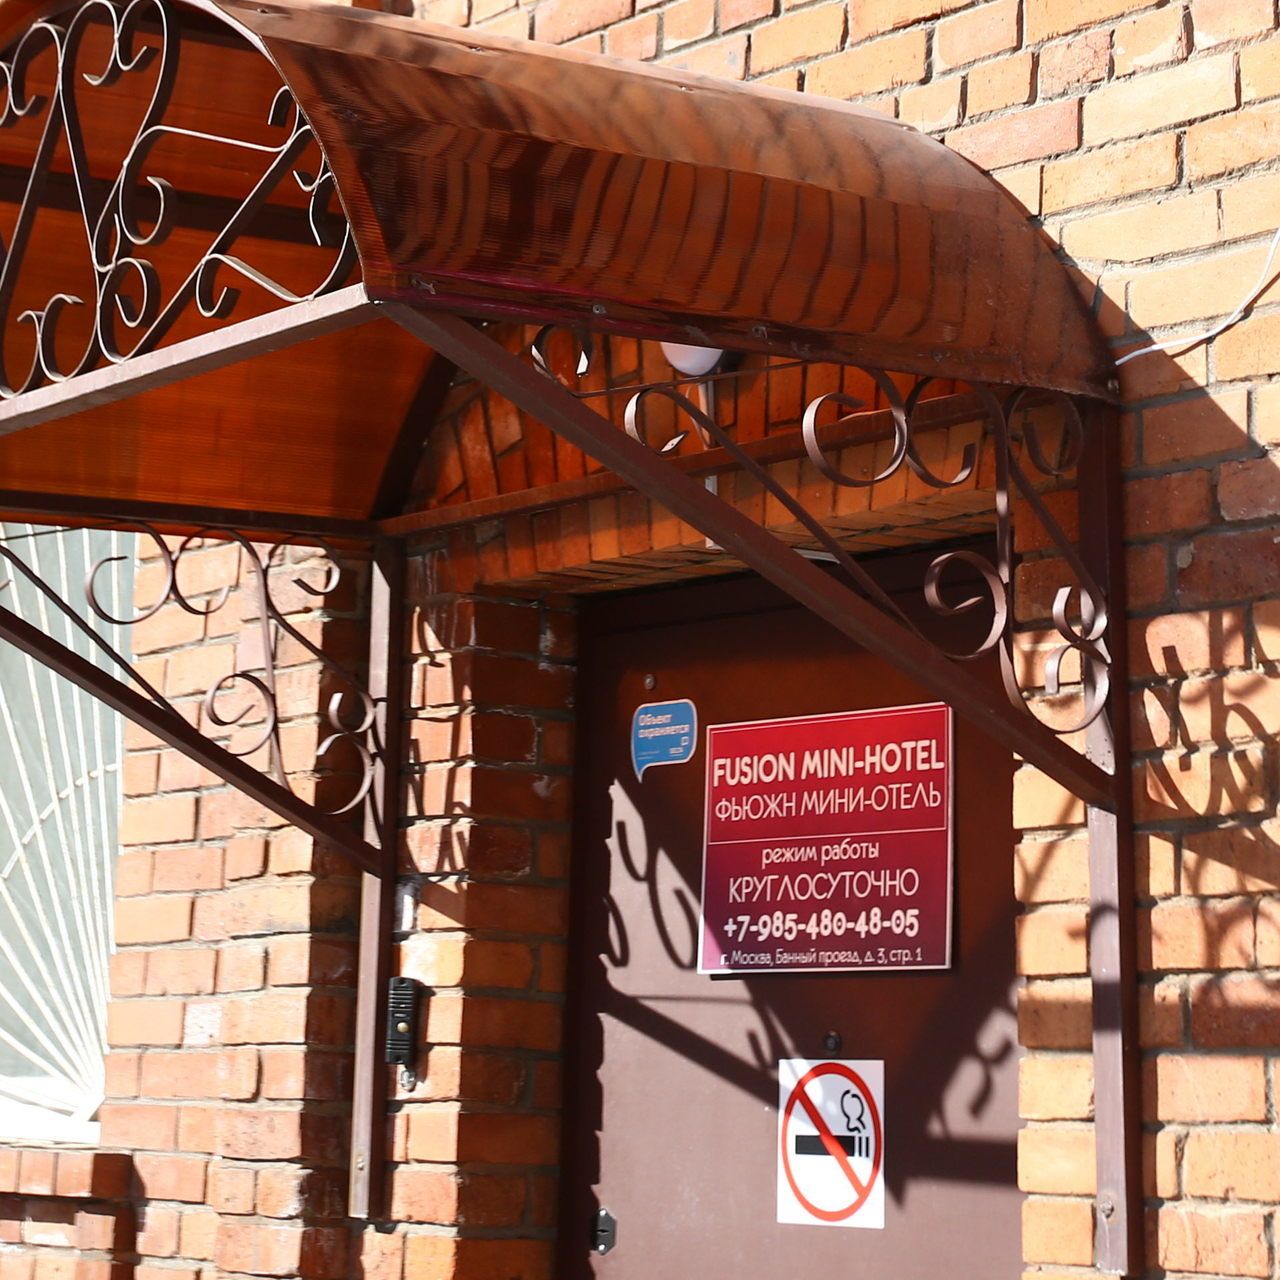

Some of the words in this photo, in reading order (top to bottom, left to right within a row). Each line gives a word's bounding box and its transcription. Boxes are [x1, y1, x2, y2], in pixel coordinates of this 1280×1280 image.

[713, 752, 795, 787] FUSION
[801, 739, 945, 780] MINI-HOTEL
[715, 792, 796, 821] ФЬЮЖН
[800, 782, 941, 816] МИНИ-ОТЕЛЬ
[761, 845, 818, 869] режим
[821, 838, 880, 868] работы
[728, 868, 920, 904] КРУГЛОСУТОЧНО
[723, 907, 920, 942] +7-985-480-48-05
[730, 950, 774, 967] Москва,
[776, 948, 816, 964] Банный
[818, 951, 863, 967] проезд,
[889, 949, 913, 965] стр.
[915, 946, 922, 961] 1
